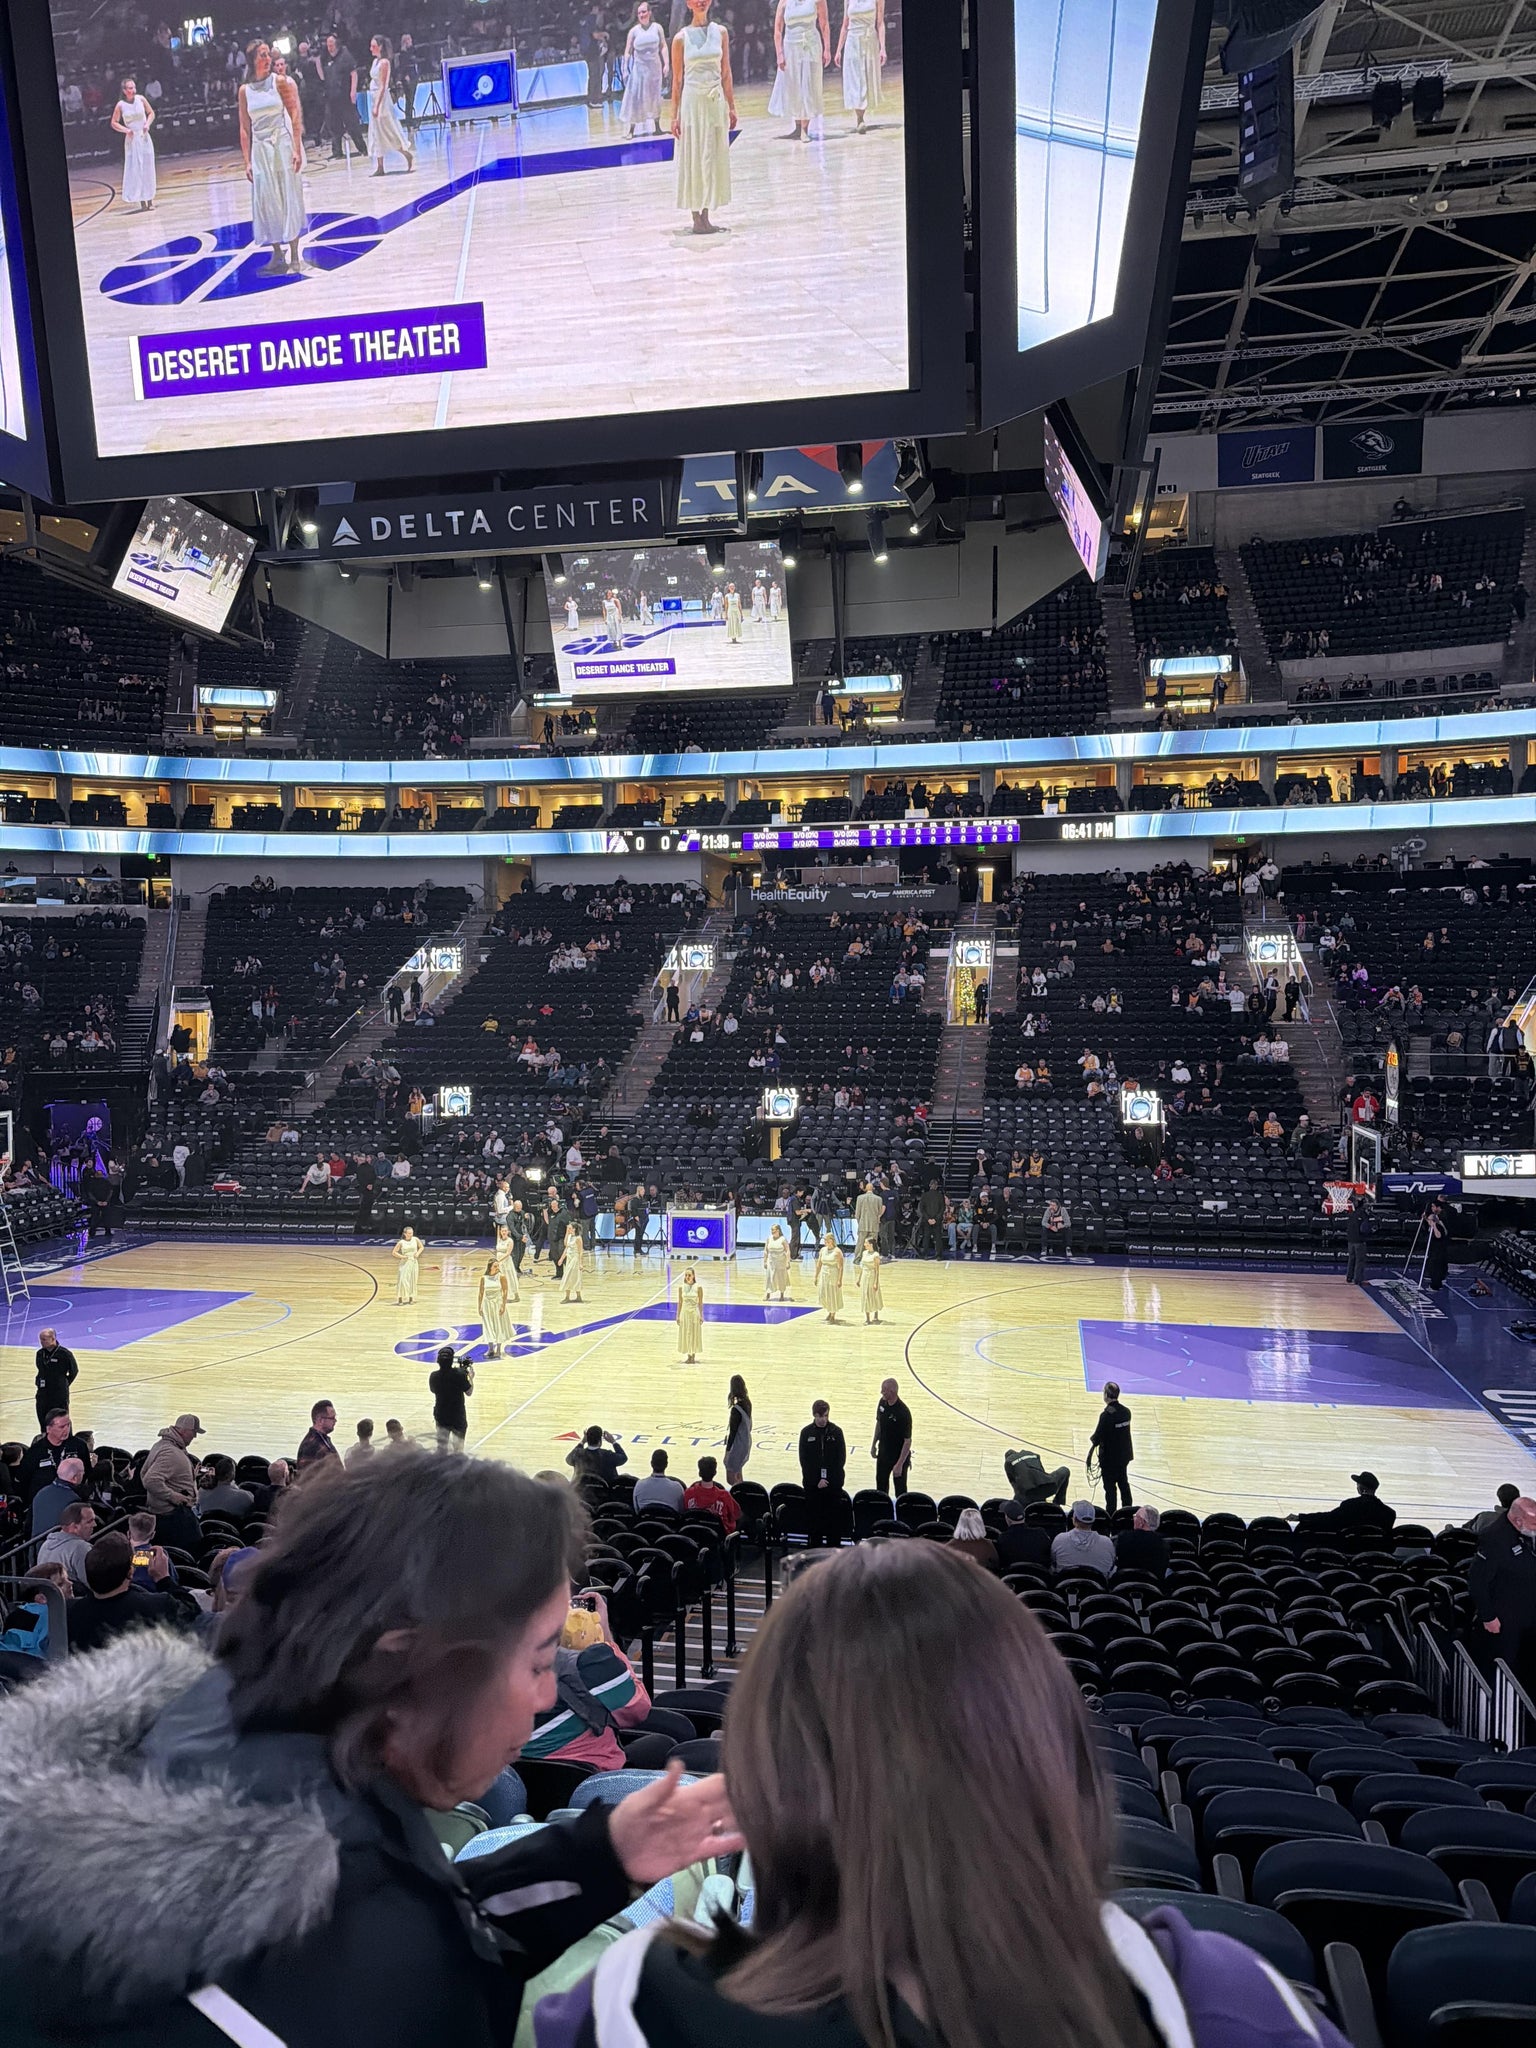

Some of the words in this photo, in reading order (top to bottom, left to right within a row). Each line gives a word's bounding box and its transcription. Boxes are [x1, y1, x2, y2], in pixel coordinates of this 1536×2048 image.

[148, 343, 251, 382] DESERET
[259, 335, 343, 372] DANCE
[349, 323, 460, 363] THEATER
[1241, 442, 1290, 469] UTAH
[371, 509, 492, 542] DELTA
[507, 497, 650, 532] CENTER
[576, 664, 608, 676] DESERET
[610, 663, 635, 675] DANCE
[637, 662, 669, 673] THEATER
[1062, 822, 1092, 839] 06:41
[1095, 822, 1113, 838] PM
[635, 836, 645, 851] 0
[661, 835, 670, 850] 0
[750, 888, 829, 903] HealthEquity
